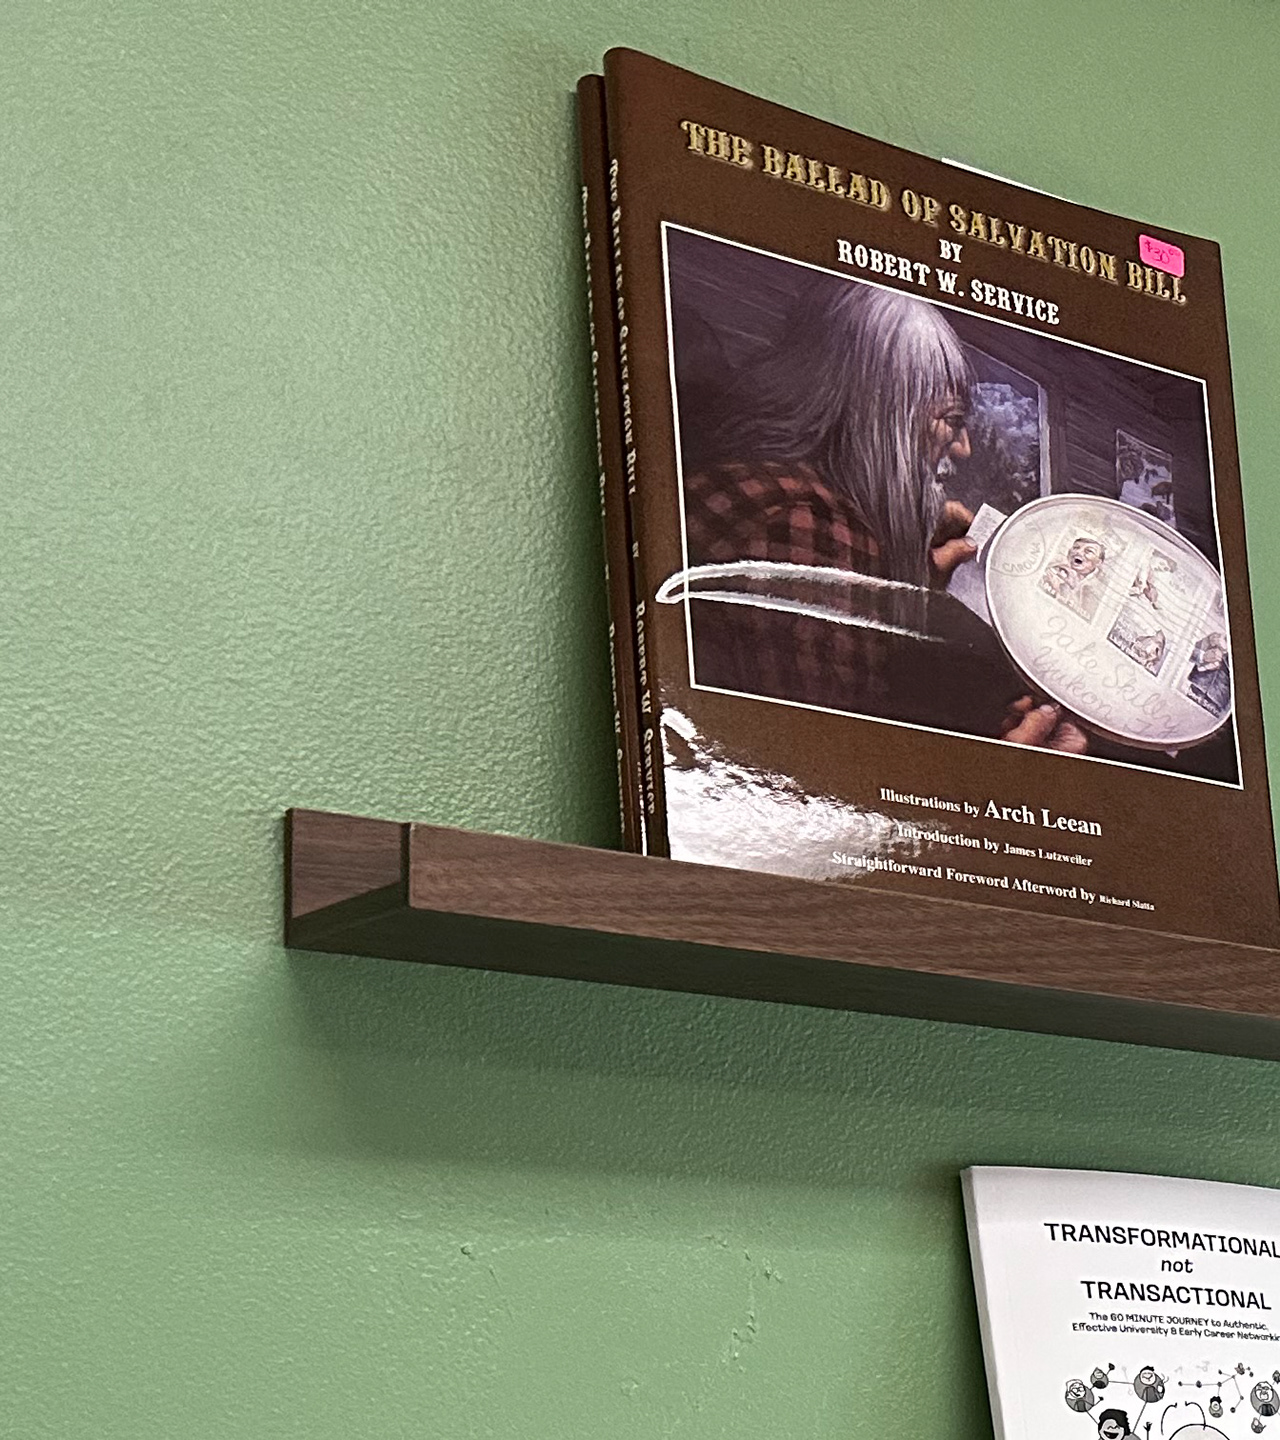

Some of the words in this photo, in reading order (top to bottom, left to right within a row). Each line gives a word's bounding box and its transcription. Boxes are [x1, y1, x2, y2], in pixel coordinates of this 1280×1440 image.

[680, 119, 752, 170] THE
[761, 144, 892, 212] BALLAD
[902, 189, 941, 233] OF
[948, 203, 1118, 283] SALVATION
[1126, 260, 1188, 304] BILL
[939, 240, 964, 263] BY
[837, 239, 931, 287] ROBERT
[936, 268, 964, 298] W.
[971, 279, 1061, 326] SERVICE
[880, 788, 961, 814] Illustrations
[963, 801, 980, 817] by
[984, 799, 1036, 827] Arch
[1041, 808, 1102, 837] Leean
[897, 825, 981, 849] Introduction
[983, 838, 1000, 854] by
[1003, 843, 1036, 859] James
[1038, 848, 1093, 868] Lutzweiler
[832, 850, 943, 880] Straightforward
[946, 867, 1009, 890] Foreword
[1012, 878, 1077, 900] Afterword
[1080, 887, 1096, 904] by
[1160, 1258, 1194, 1274] not
[1080, 1280, 1272, 1310] TRANSACTIONAL
[1072, 1322, 1118, 1334] Effective
[1119, 1324, 1168, 1337] University
[1179, 1327, 1202, 1340] Early
[1203, 1329, 1236, 1339] Career
